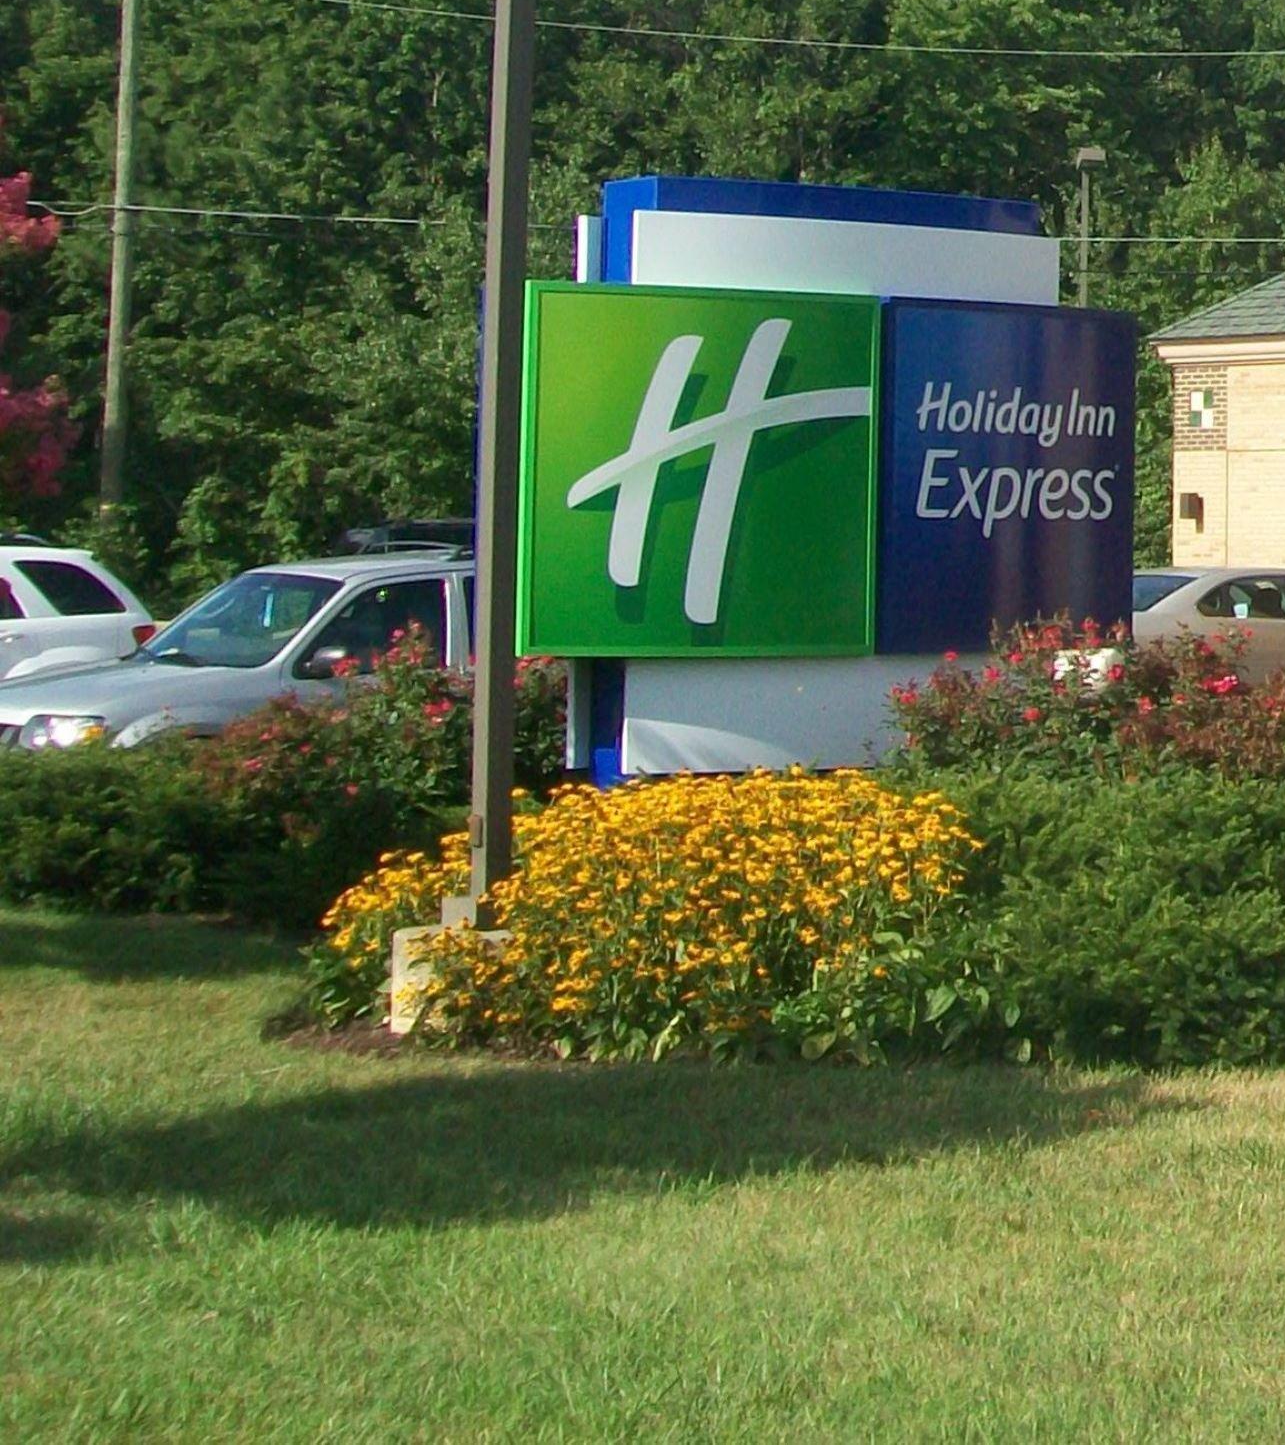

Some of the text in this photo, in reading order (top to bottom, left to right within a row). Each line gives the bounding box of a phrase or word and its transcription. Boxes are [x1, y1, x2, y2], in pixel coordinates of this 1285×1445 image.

[916, 381, 1116, 447] Holiday Inn
[916, 448, 1115, 539] Express
